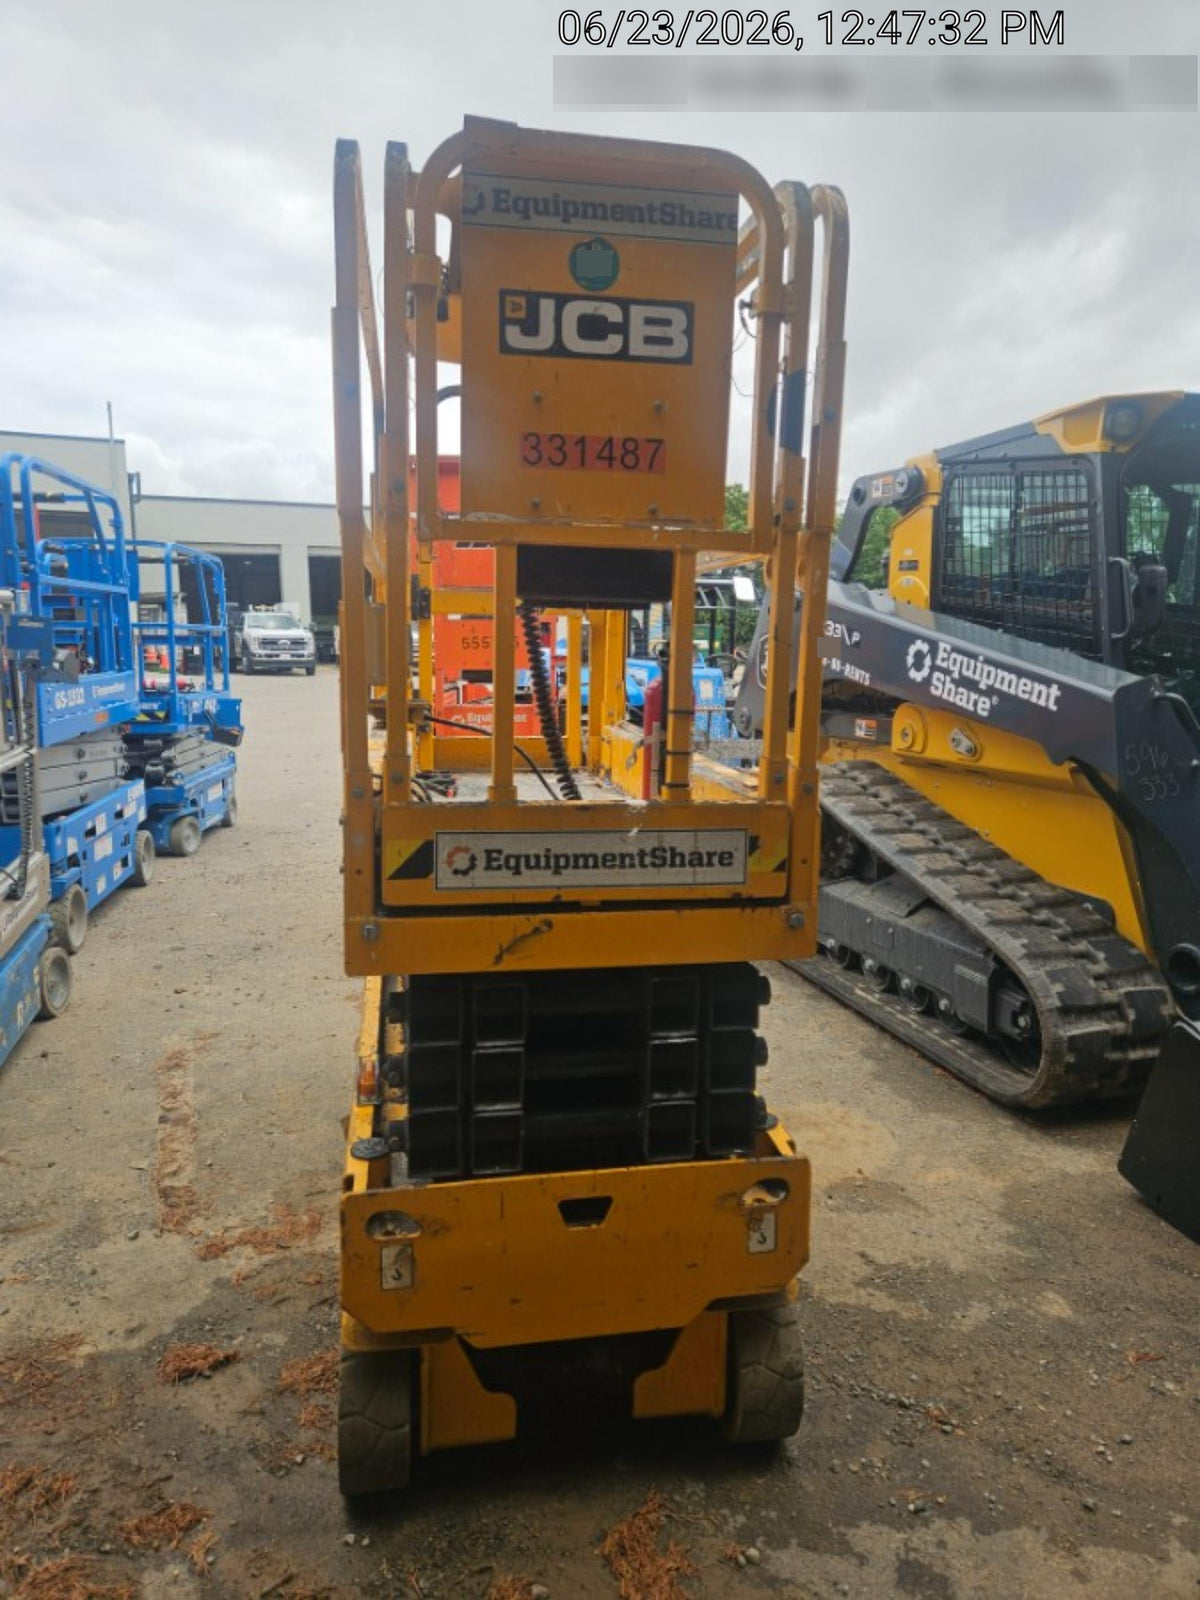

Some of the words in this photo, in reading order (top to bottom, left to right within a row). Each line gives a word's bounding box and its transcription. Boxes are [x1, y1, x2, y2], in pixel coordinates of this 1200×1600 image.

[490, 187, 738, 231] EquipmentShare
[505, 298, 689, 359] JCB
[523, 432, 665, 471] 331487
[930, 671, 990, 717] Share
[935, 641, 1061, 712] Equipment
[483, 845, 734, 876] EquipmentShare
